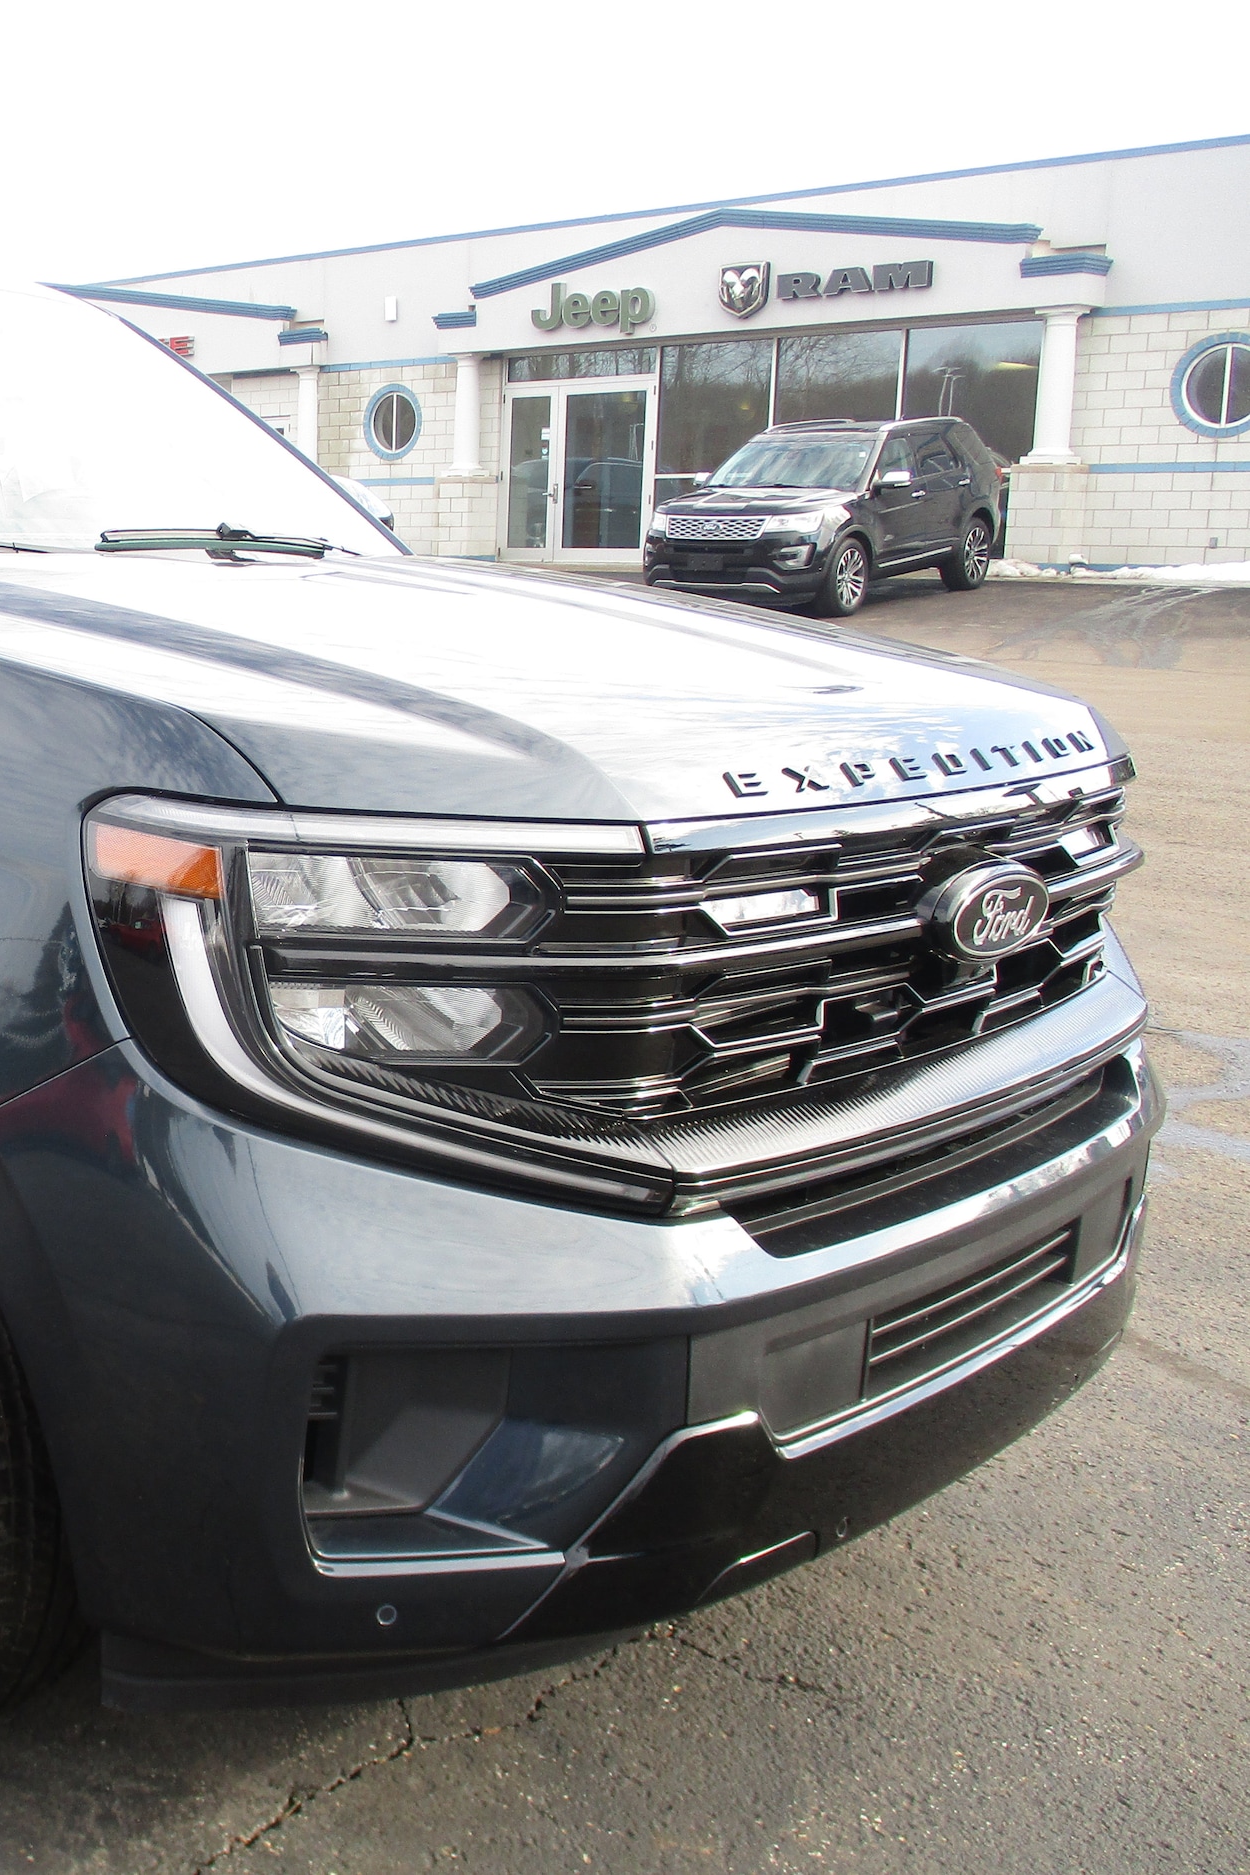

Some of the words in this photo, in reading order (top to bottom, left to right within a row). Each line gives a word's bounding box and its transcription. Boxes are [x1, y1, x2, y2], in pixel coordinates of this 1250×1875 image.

[777, 260, 933, 300] RAM
[531, 283, 654, 334] Jeep
[722, 731, 1095, 798] EXPEDITION
[973, 886, 1034, 946] Ford
